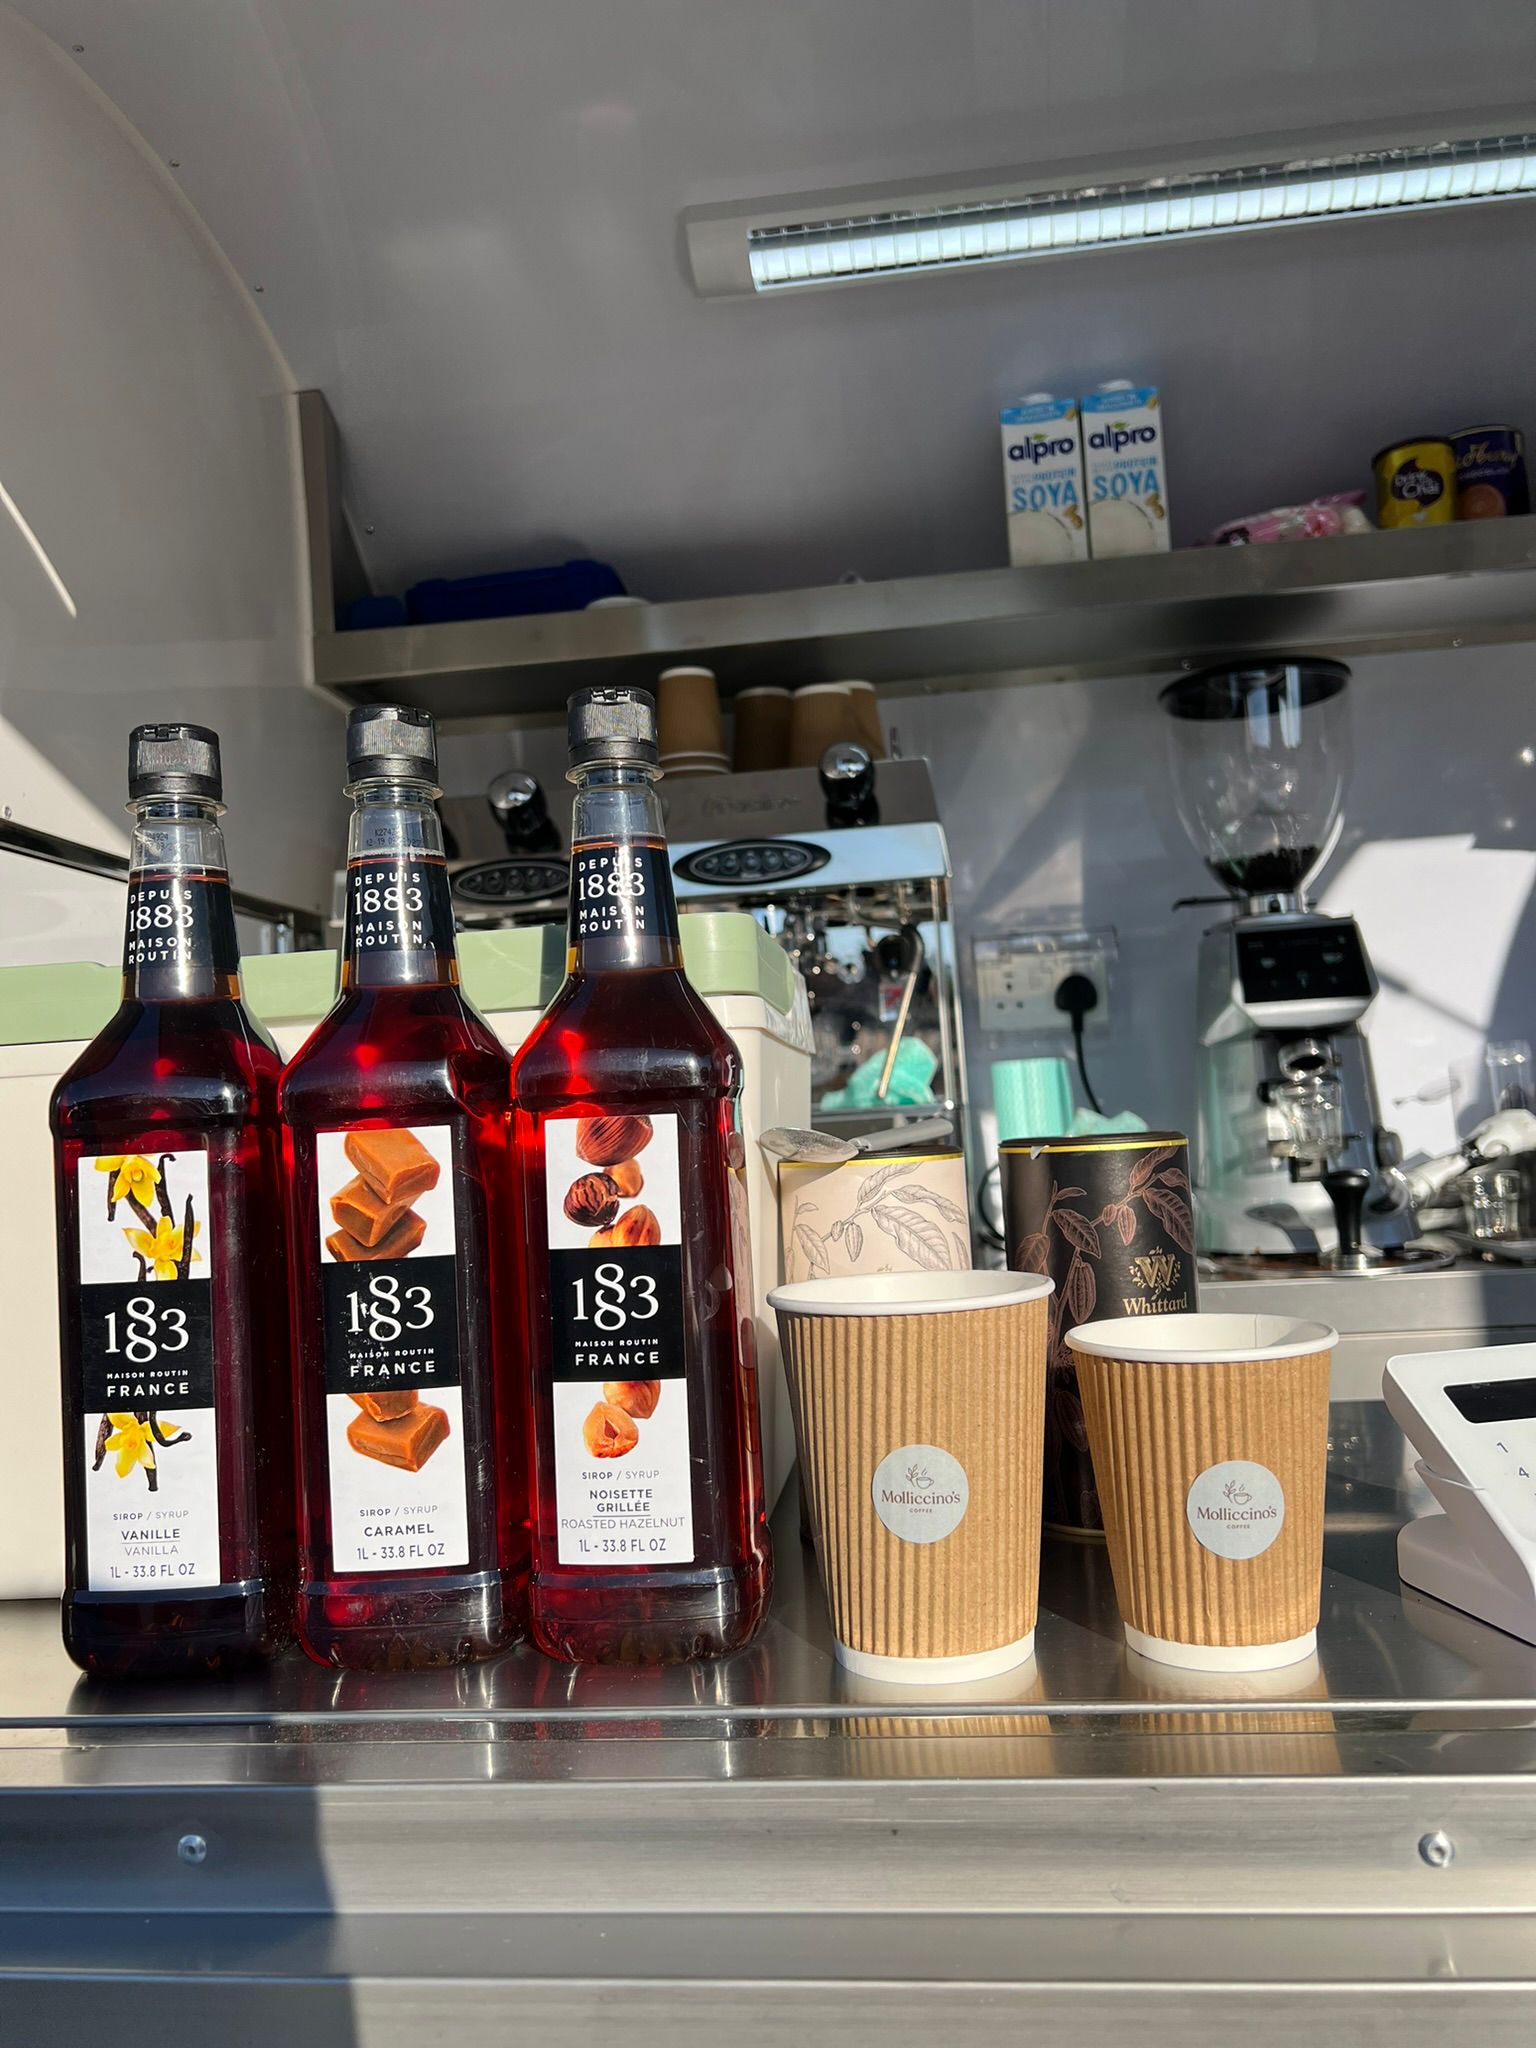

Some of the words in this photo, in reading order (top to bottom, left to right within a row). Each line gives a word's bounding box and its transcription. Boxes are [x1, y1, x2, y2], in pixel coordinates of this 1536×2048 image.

[1089, 424, 1156, 453] alpro
[1008, 436, 1075, 465] alpro
[1094, 469, 1160, 500] SOYA
[1013, 480, 1078, 512] SOYA
[579, 857, 643, 871] DEPUS
[355, 872, 420, 886] DEPUIS
[579, 872, 645, 900] 1883
[130, 890, 192, 904] DEPUS
[354, 887, 423, 915] 1883
[129, 904, 194, 932] 1883
[580, 919, 645, 934] ROUTN
[129, 937, 192, 951] MAISON
[356, 934, 422, 948] ROUTN
[1122, 1291, 1187, 1315] Whittard
[620, 1338, 659, 1346] ROUTIN
[350, 1351, 389, 1359] MAISON
[395, 1348, 435, 1356] ROUTIN
[575, 1351, 660, 1366] FRANCE
[106, 1371, 145, 1379] MAISON
[150, 1370, 189, 1378] ROUTIN
[350, 1360, 435, 1377] FRANCE
[107, 1382, 189, 1397] FRANCE
[1496, 1442, 1508, 1453] 1
[581, 1471, 613, 1480] SIROP
[625, 1470, 660, 1480] SYRUP
[1518, 1467, 1530, 1478] 4
[589, 1489, 653, 1500] NOISETTE
[881, 1489, 961, 1505] Molliccino's
[359, 1508, 391, 1517] SIROP
[403, 1505, 438, 1515] SYRUP
[596, 1500, 650, 1512] GRILLÉE
[1196, 1505, 1277, 1520] Molliccino's
[112, 1513, 144, 1521] SIROP
[155, 1510, 189, 1519] SYRUP
[561, 1518, 616, 1529] ROASTED
[619, 1516, 686, 1529] HAZELNUT
[121, 1528, 181, 1541] VANILLE
[364, 1523, 435, 1537] CARAMEL
[124, 1545, 179, 1556] VANILLA
[357, 1547, 369, 1560] 1L
[380, 1546, 406, 1559] 33.8
[409, 1544, 424, 1557] FL
[427, 1543, 446, 1556] OZ
[579, 1539, 590, 1552] 1L
[602, 1539, 627, 1552] 33.8
[631, 1539, 645, 1552] FL
[649, 1538, 667, 1551] OZ
[110, 1566, 121, 1578] 1L
[133, 1565, 157, 1578] 33.8
[160, 1564, 174, 1577] FL
[178, 1563, 196, 1576] OZ
